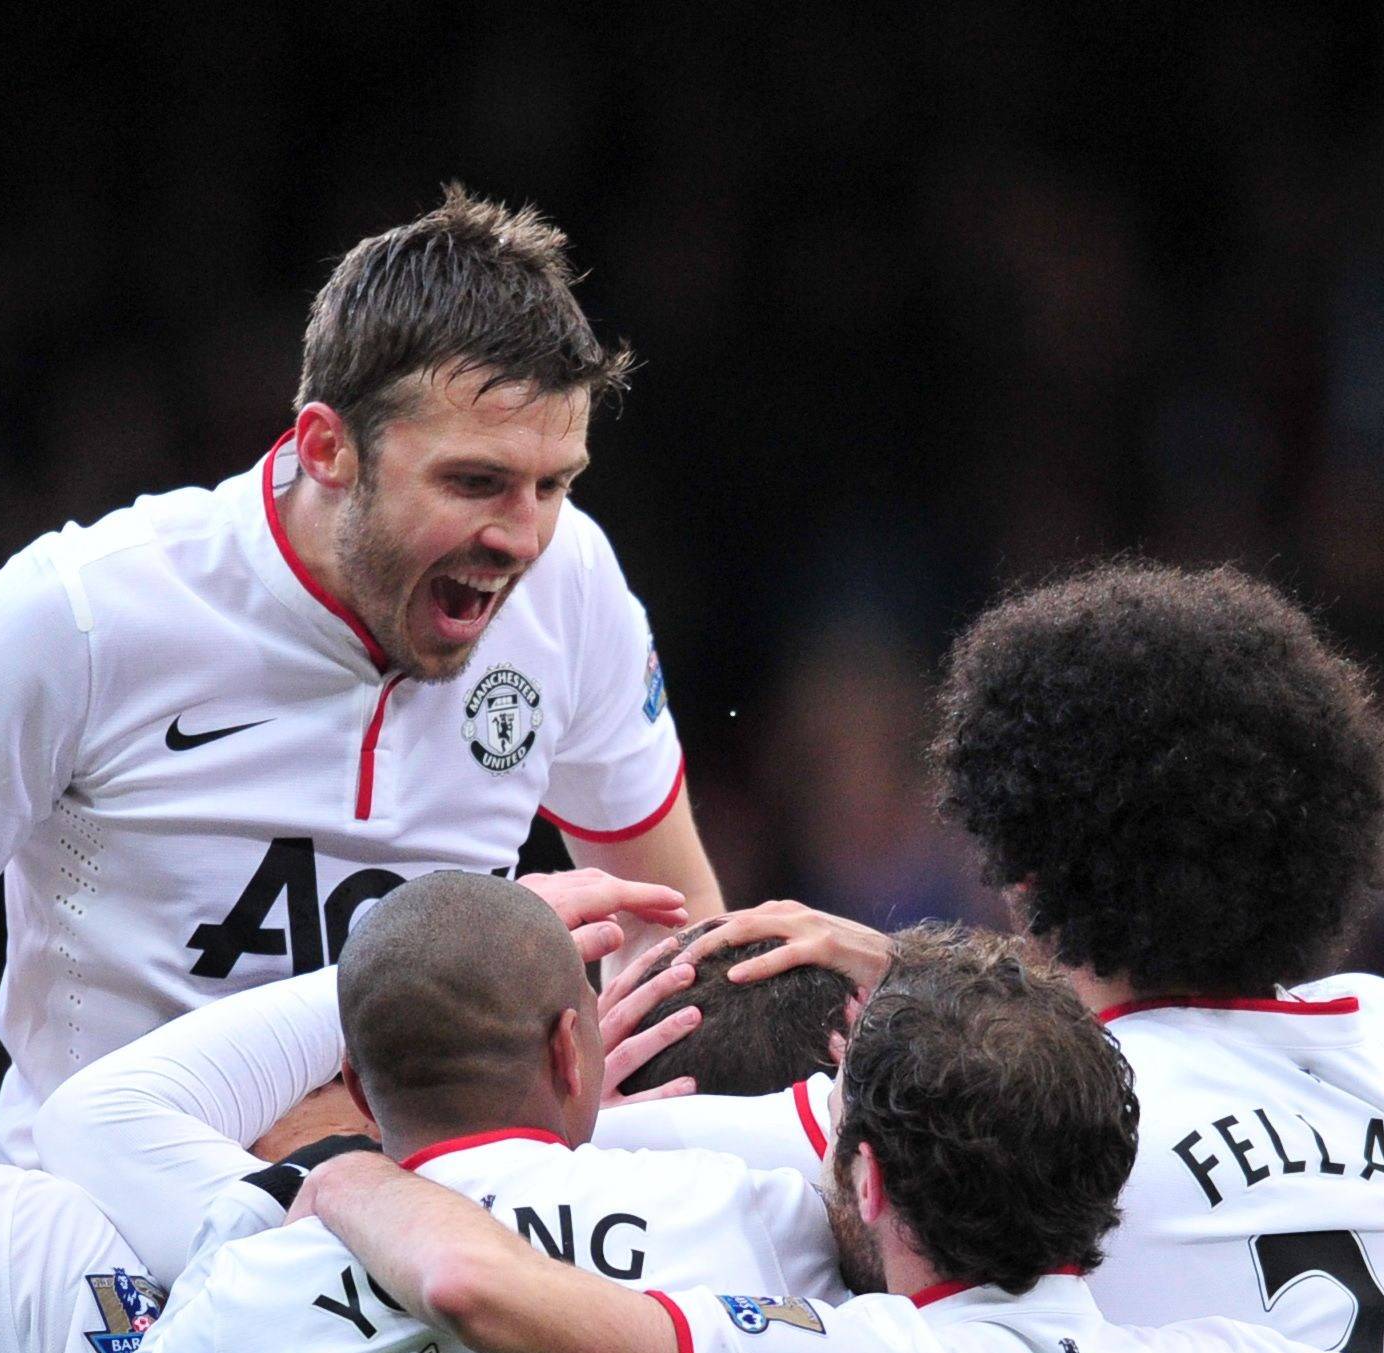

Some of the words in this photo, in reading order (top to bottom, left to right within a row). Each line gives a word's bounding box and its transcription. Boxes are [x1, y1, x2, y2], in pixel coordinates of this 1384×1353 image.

[469, 671, 537, 712] MANCHESTER
[482, 746, 527, 769] UNITED
[312, 1203, 648, 1340] YNG
